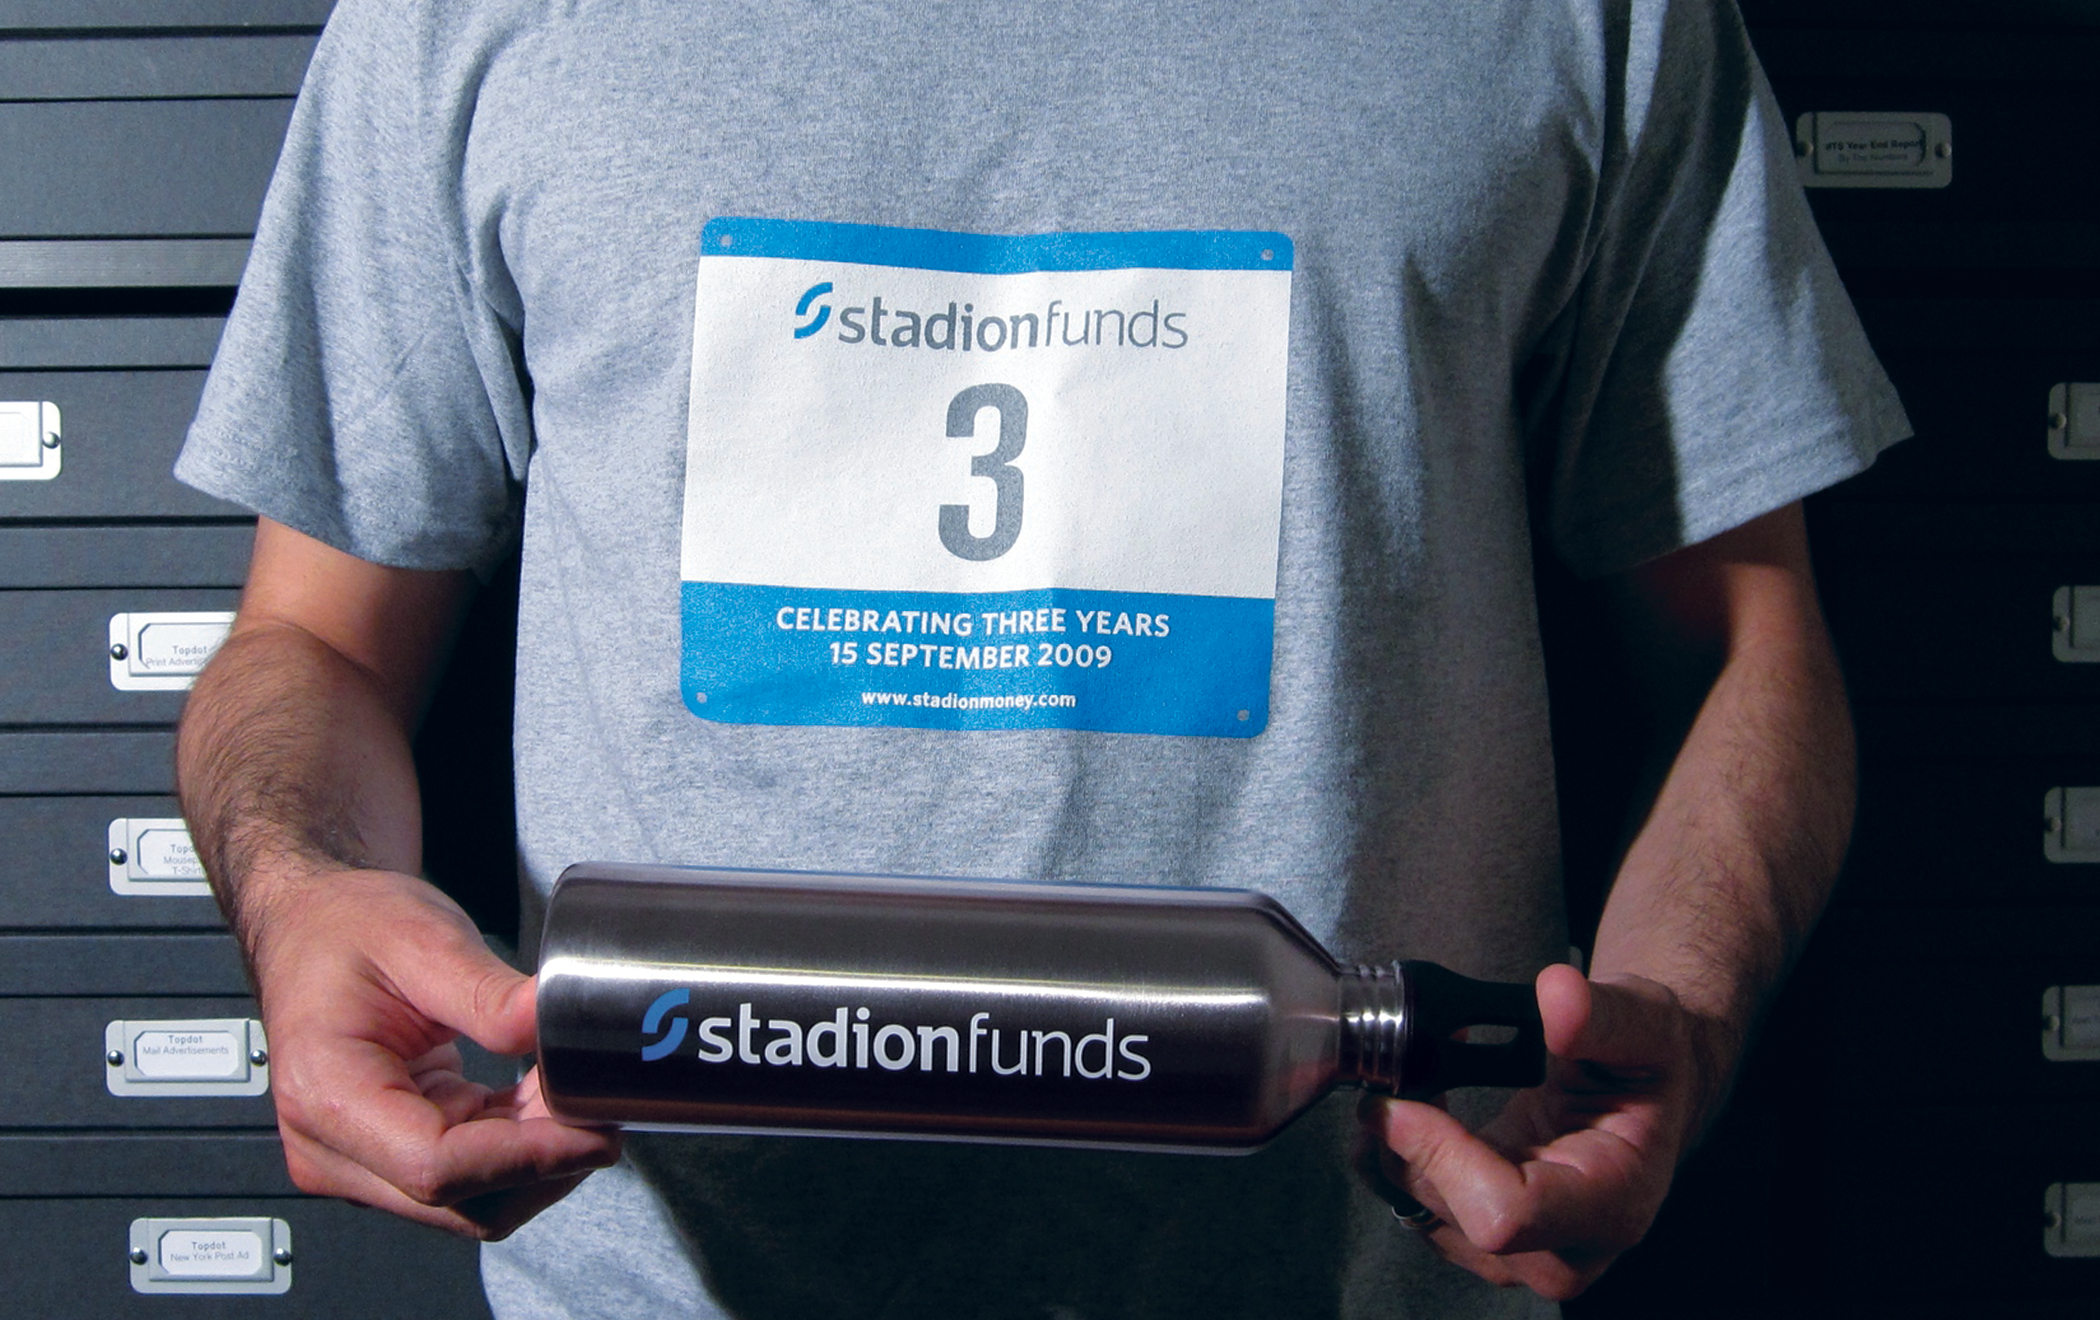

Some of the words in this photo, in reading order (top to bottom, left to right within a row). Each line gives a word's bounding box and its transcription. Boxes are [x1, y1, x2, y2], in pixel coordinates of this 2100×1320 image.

[1870, 139, 1889, 150] End
[838, 295, 1189, 352] stadionfunds
[937, 382, 1029, 562] 3
[776, 606, 972, 637] CELEBRATING
[981, 608, 1067, 636] THREE
[1075, 609, 1171, 638] YEARS
[172, 645, 208, 656] Topdot
[829, 642, 858, 665] 15
[866, 642, 1030, 670] SEPTEMBER
[1037, 643, 1113, 669] 2009
[146, 656, 167, 666] Print
[861, 689, 1077, 710] www.stadionmoney.com
[163, 855, 200, 867] Mousep
[168, 1035, 203, 1045] Topdot
[698, 1002, 1151, 1081] stadionfunds
[142, 1046, 161, 1055] Mail
[163, 1046, 230, 1055] Advertisements
[191, 1241, 226, 1251] Topdot
[170, 1253, 190, 1262] New
[192, 1252, 212, 1261] York
[214, 1252, 235, 1261] Post
[237, 1250, 249, 1260] Ad
